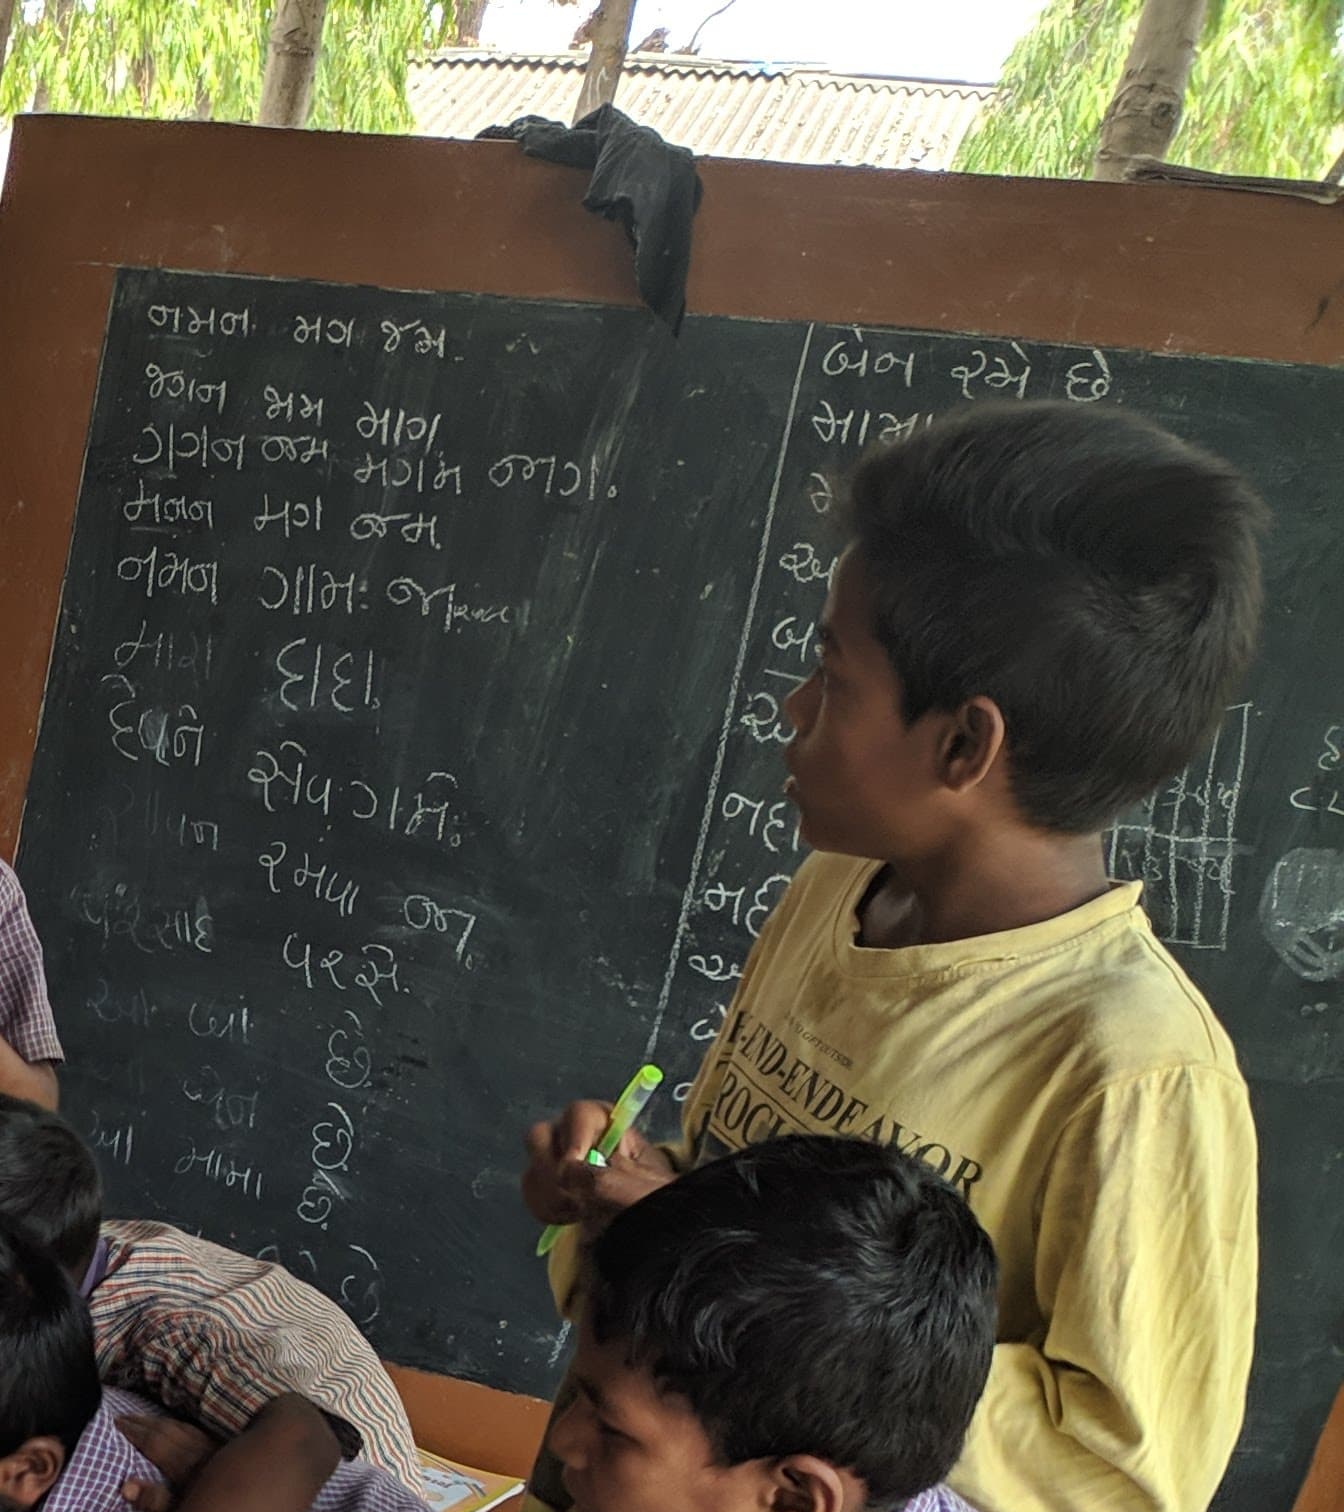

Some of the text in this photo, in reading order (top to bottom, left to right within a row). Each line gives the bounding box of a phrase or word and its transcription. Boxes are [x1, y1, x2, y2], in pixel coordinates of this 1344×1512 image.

[148, 305, 250, 338] નમન
[293, 315, 355, 348] મગ
[132, 422, 245, 479] ગગન
[261, 434, 329, 463] જમ
[254, 494, 321, 538] મગ
[117, 546, 218, 606] નમન
